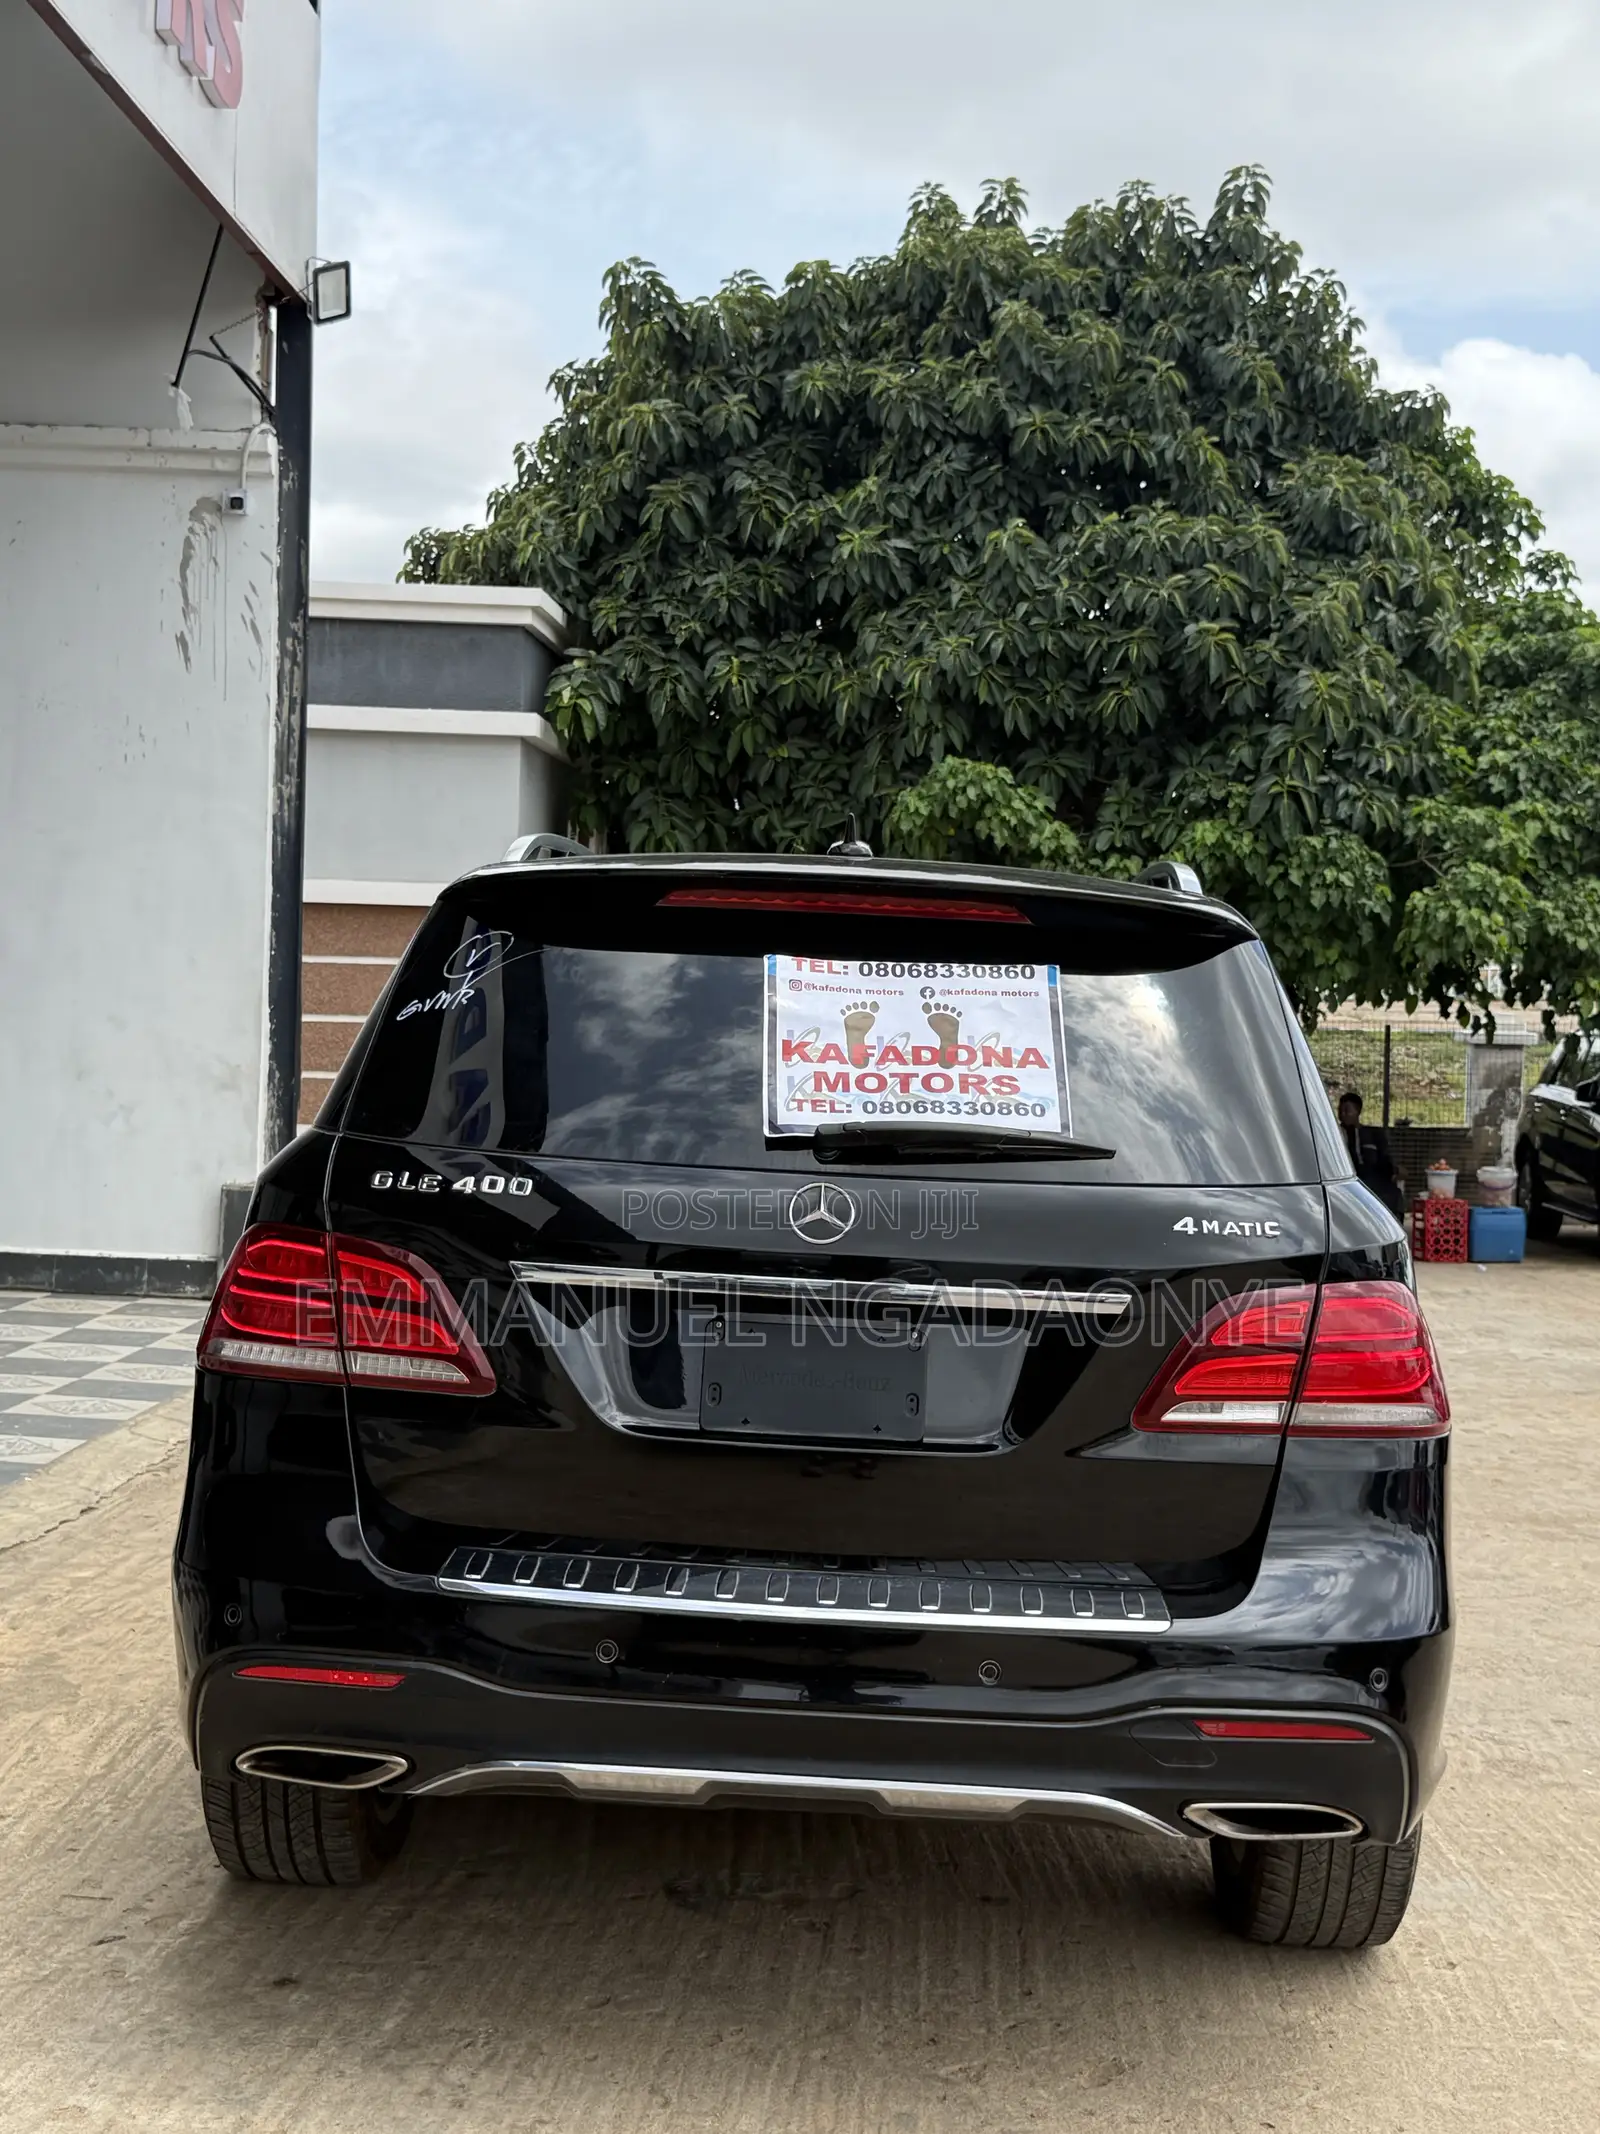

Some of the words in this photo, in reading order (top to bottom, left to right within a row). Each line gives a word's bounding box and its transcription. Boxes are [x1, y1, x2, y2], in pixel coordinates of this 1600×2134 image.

[790, 956, 849, 976] TEL:
[858, 961, 1036, 981] 08068330860
[803, 982, 863, 996] @kafadona
[864, 987, 905, 997] motors
[938, 988, 998, 998] @kafadona
[1000, 988, 1040, 998] motors
[781, 1039, 1050, 1070] KAFADONA
[813, 1070, 1021, 1096] MOTORS
[790, 1098, 853, 1115] TEL:
[861, 1100, 1047, 1119] 08068330860
[370, 1170, 443, 1193] GLE
[451, 1174, 534, 1197] 400
[1172, 1216, 1281, 1238] 4MATIC
